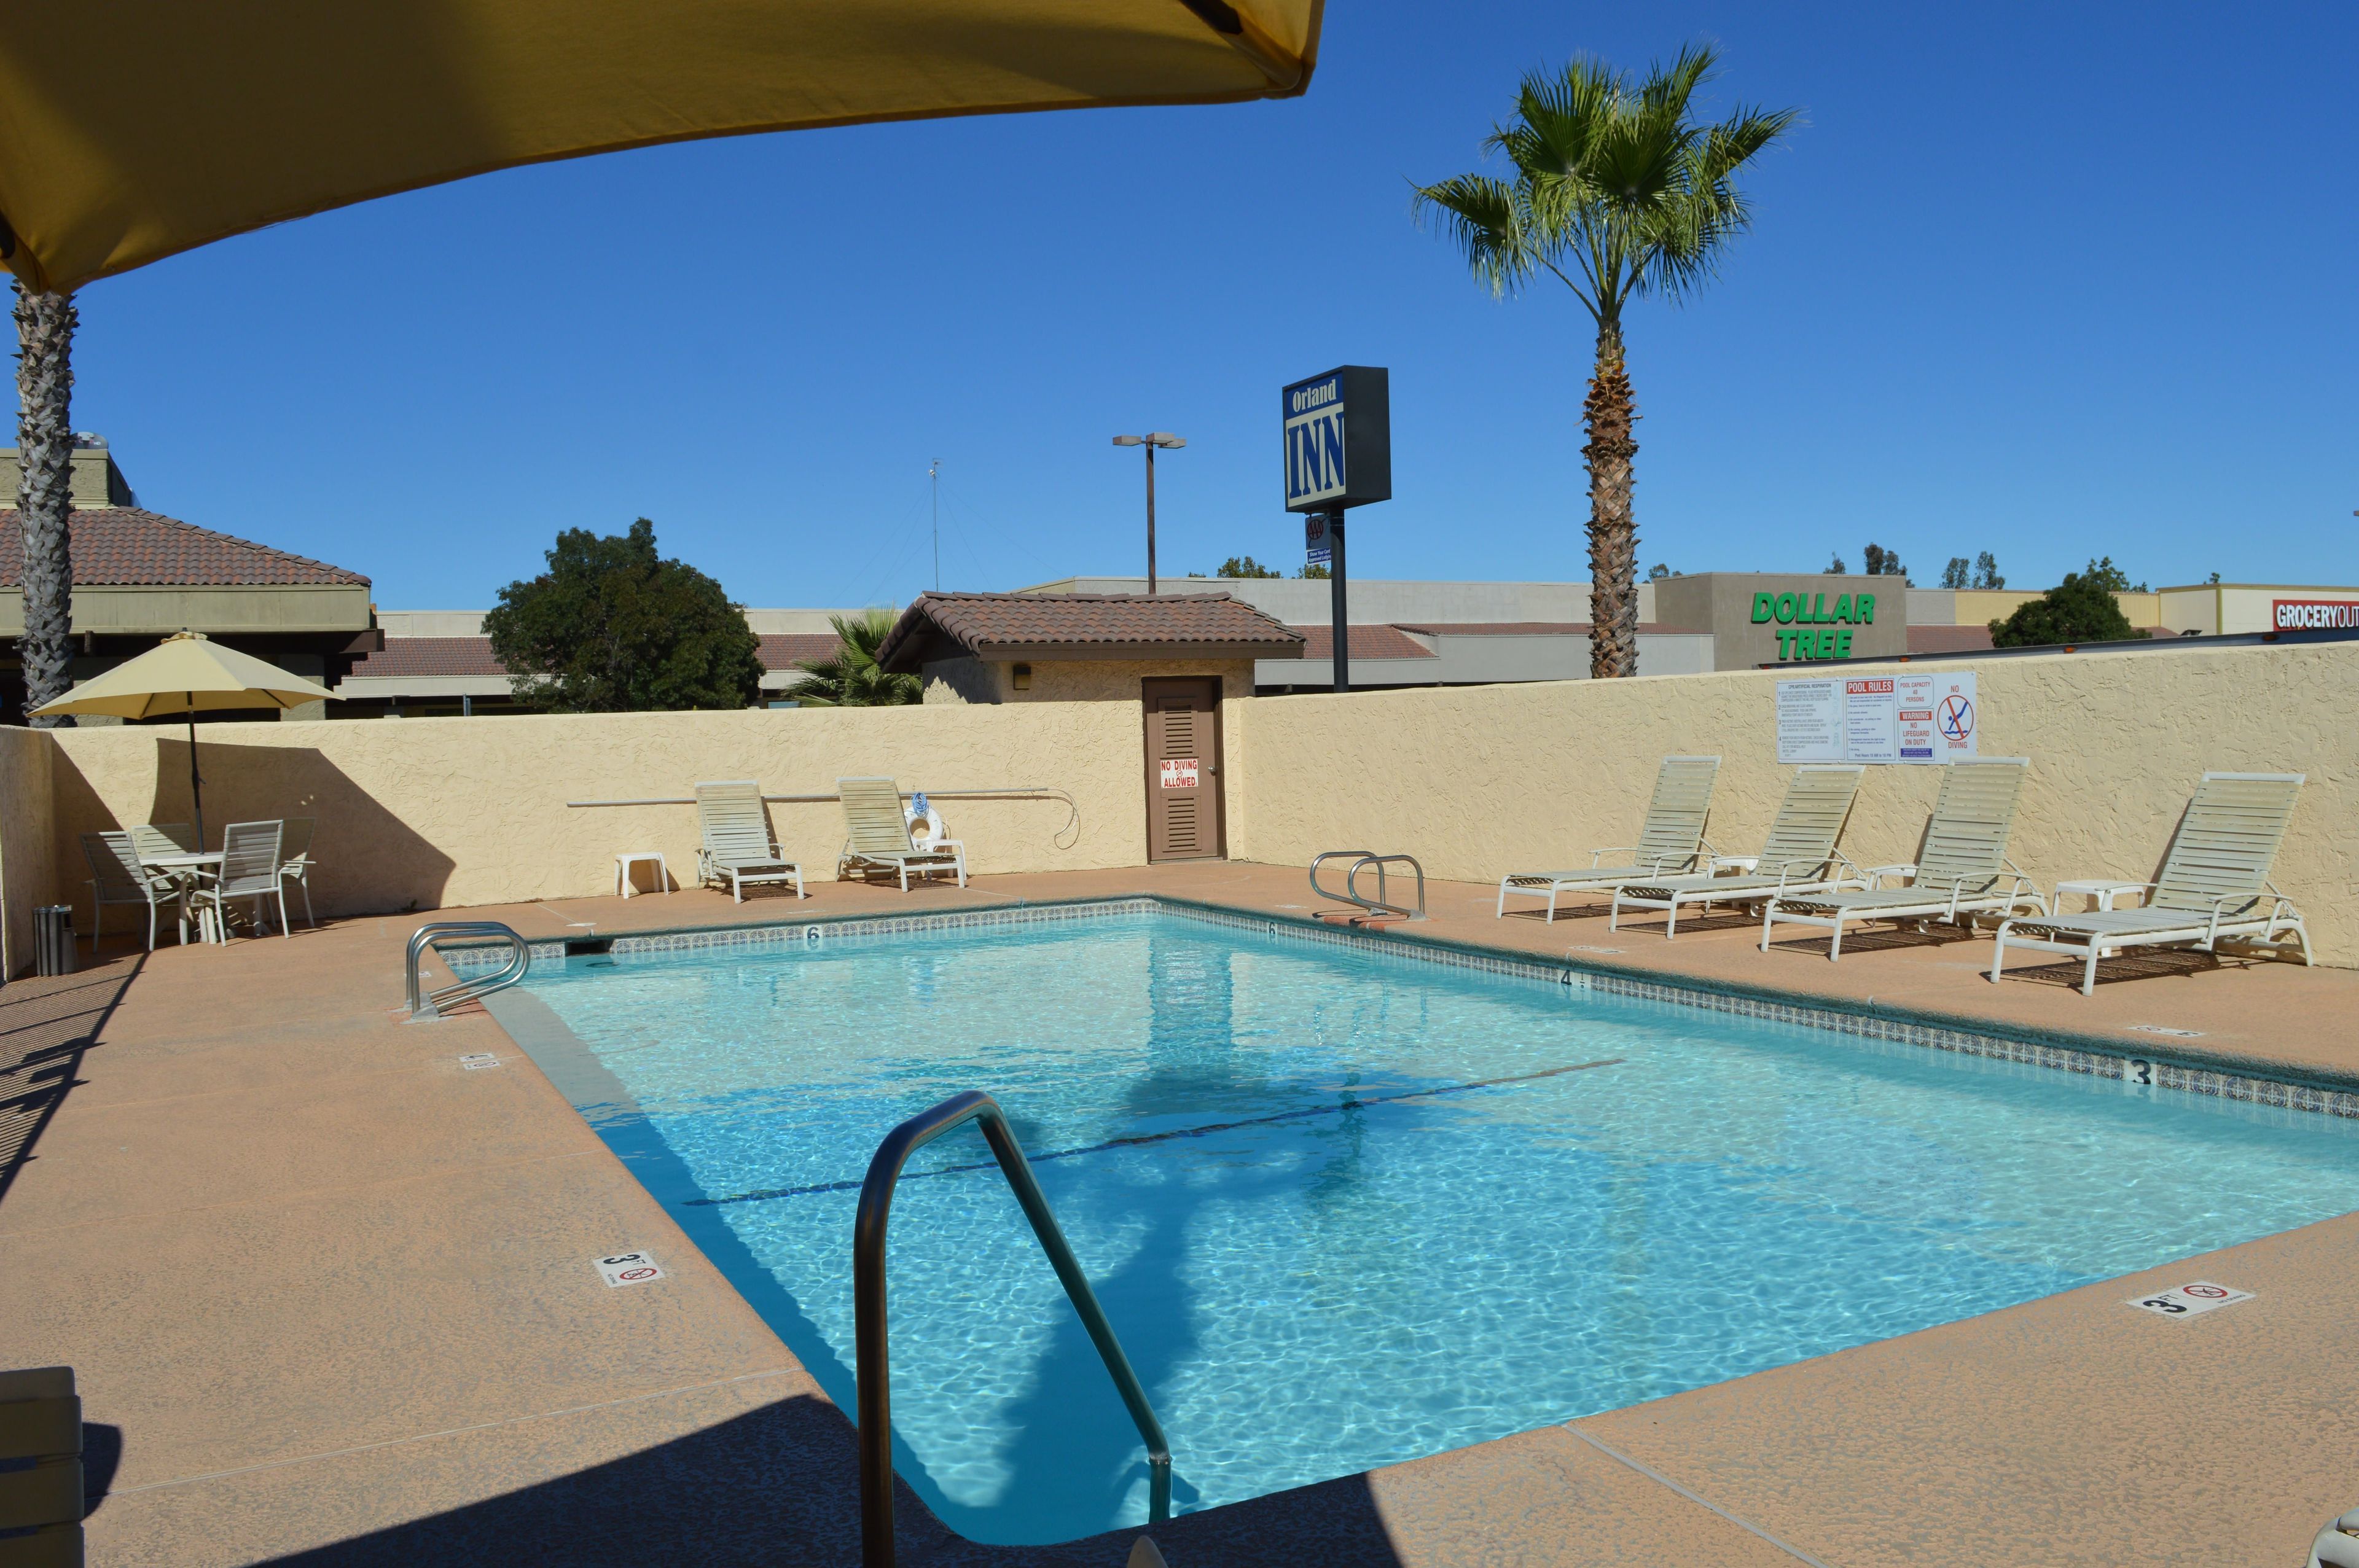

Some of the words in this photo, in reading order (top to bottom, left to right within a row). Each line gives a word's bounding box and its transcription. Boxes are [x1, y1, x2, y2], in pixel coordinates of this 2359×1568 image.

[1293, 378, 1337, 413] Orland
[1287, 411, 1345, 500] INN
[1307, 520, 1323, 540] AAA
[1751, 592, 1876, 625] DOLLAR
[1775, 629, 1853, 660] TREE
[1848, 682, 1867, 692] POOL
[1869, 681, 1892, 692] RULES
[1161, 761, 1171, 771] NO
[1174, 760, 1197, 770] DIVING
[1164, 776, 1195, 787] ALLOWED
[807, 927, 820, 939] 6
[1269, 922, 1276, 934] 6
[1561, 970, 1572, 985] 4
[2131, 1059, 2151, 1085] 3
[603, 1254, 641, 1265] 3
[2143, 1300, 2188, 1313] 3
